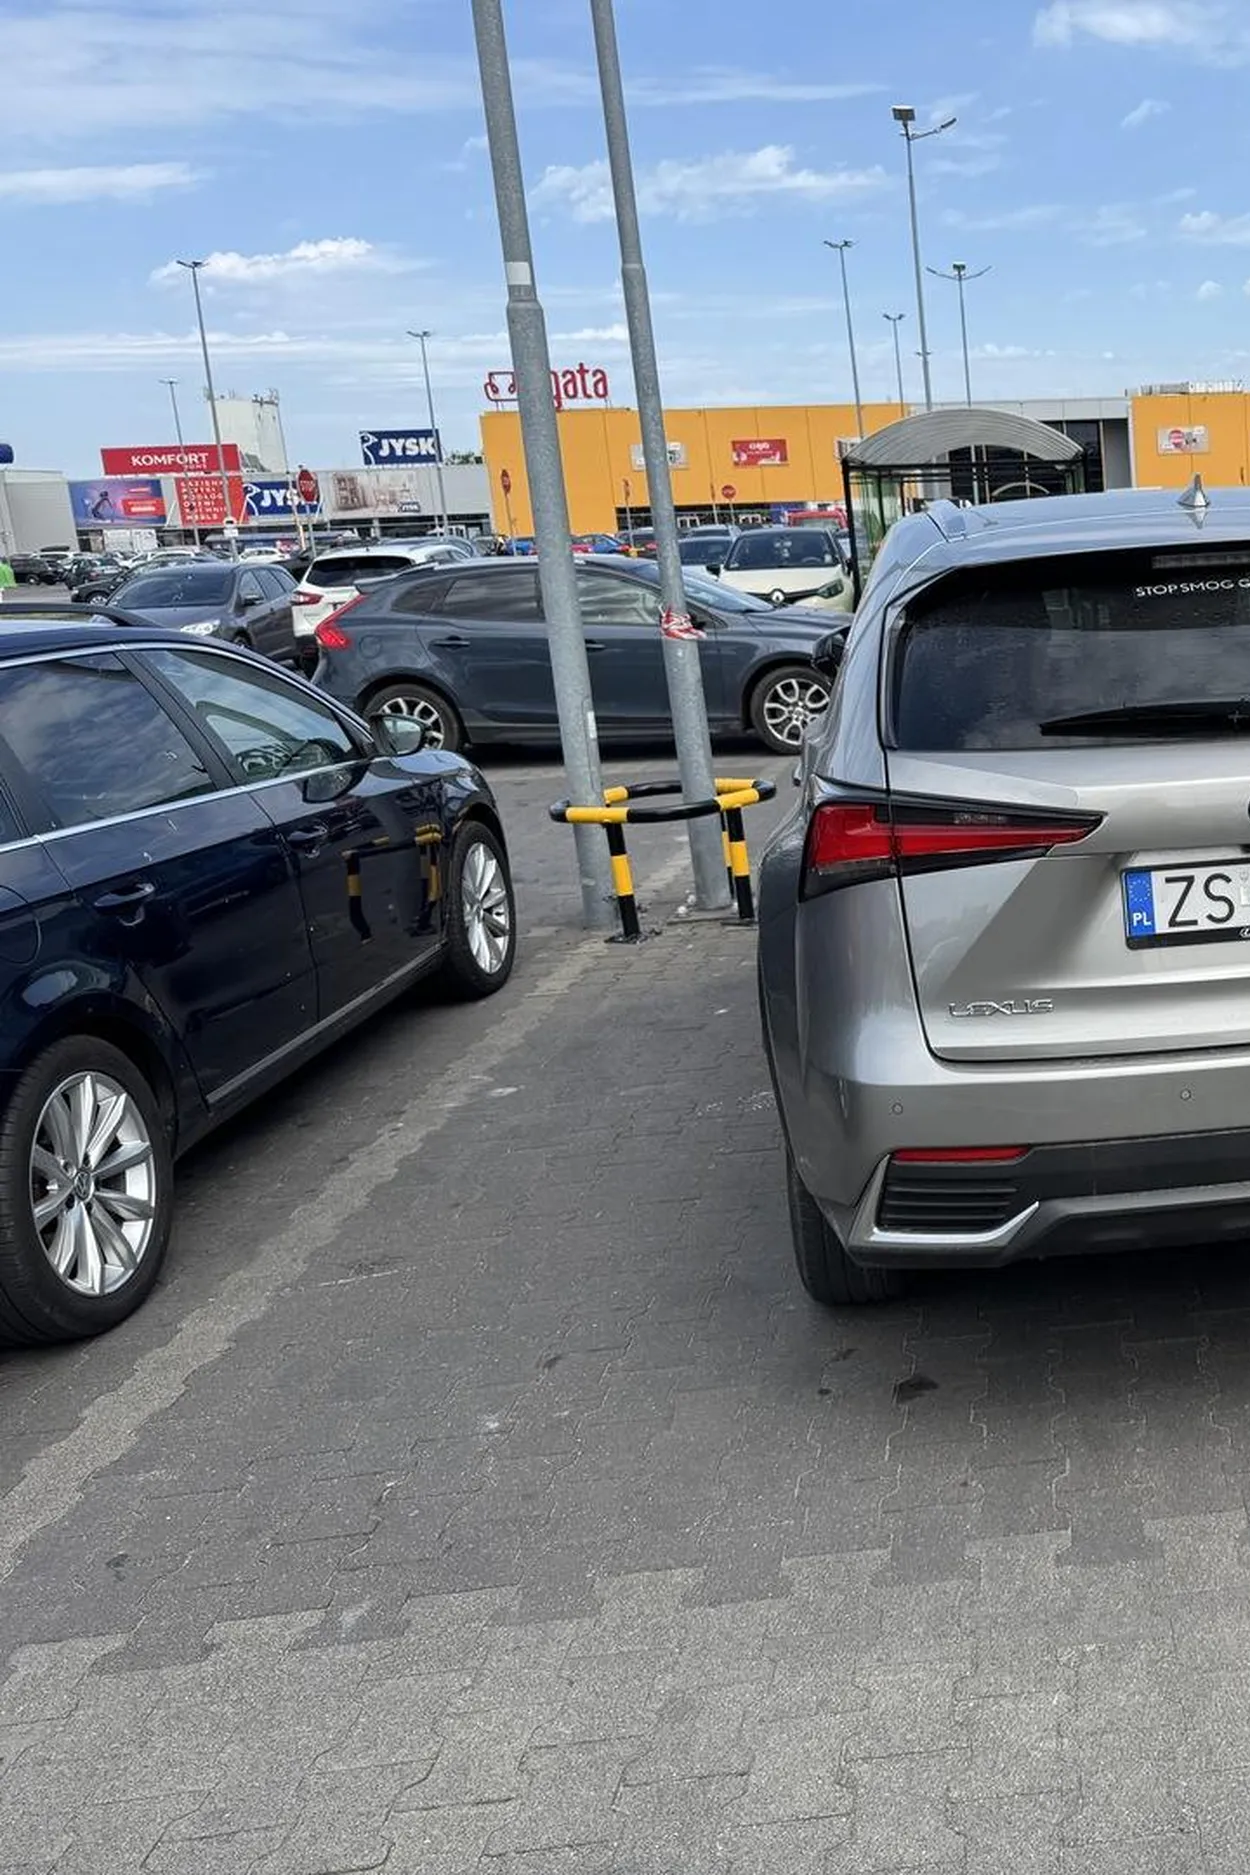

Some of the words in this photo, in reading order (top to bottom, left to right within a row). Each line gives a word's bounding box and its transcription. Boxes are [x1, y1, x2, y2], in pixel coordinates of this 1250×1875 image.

[377, 437, 436, 458] JYSK
[131, 452, 209, 467] KOMFORT
[1135, 583, 1178, 597] STOP
[1179, 579, 1234, 594] SMOG
[1164, 872, 1235, 928] ZS
[1132, 912, 1151, 926] PL
[948, 998, 1055, 1018] LEXUS
